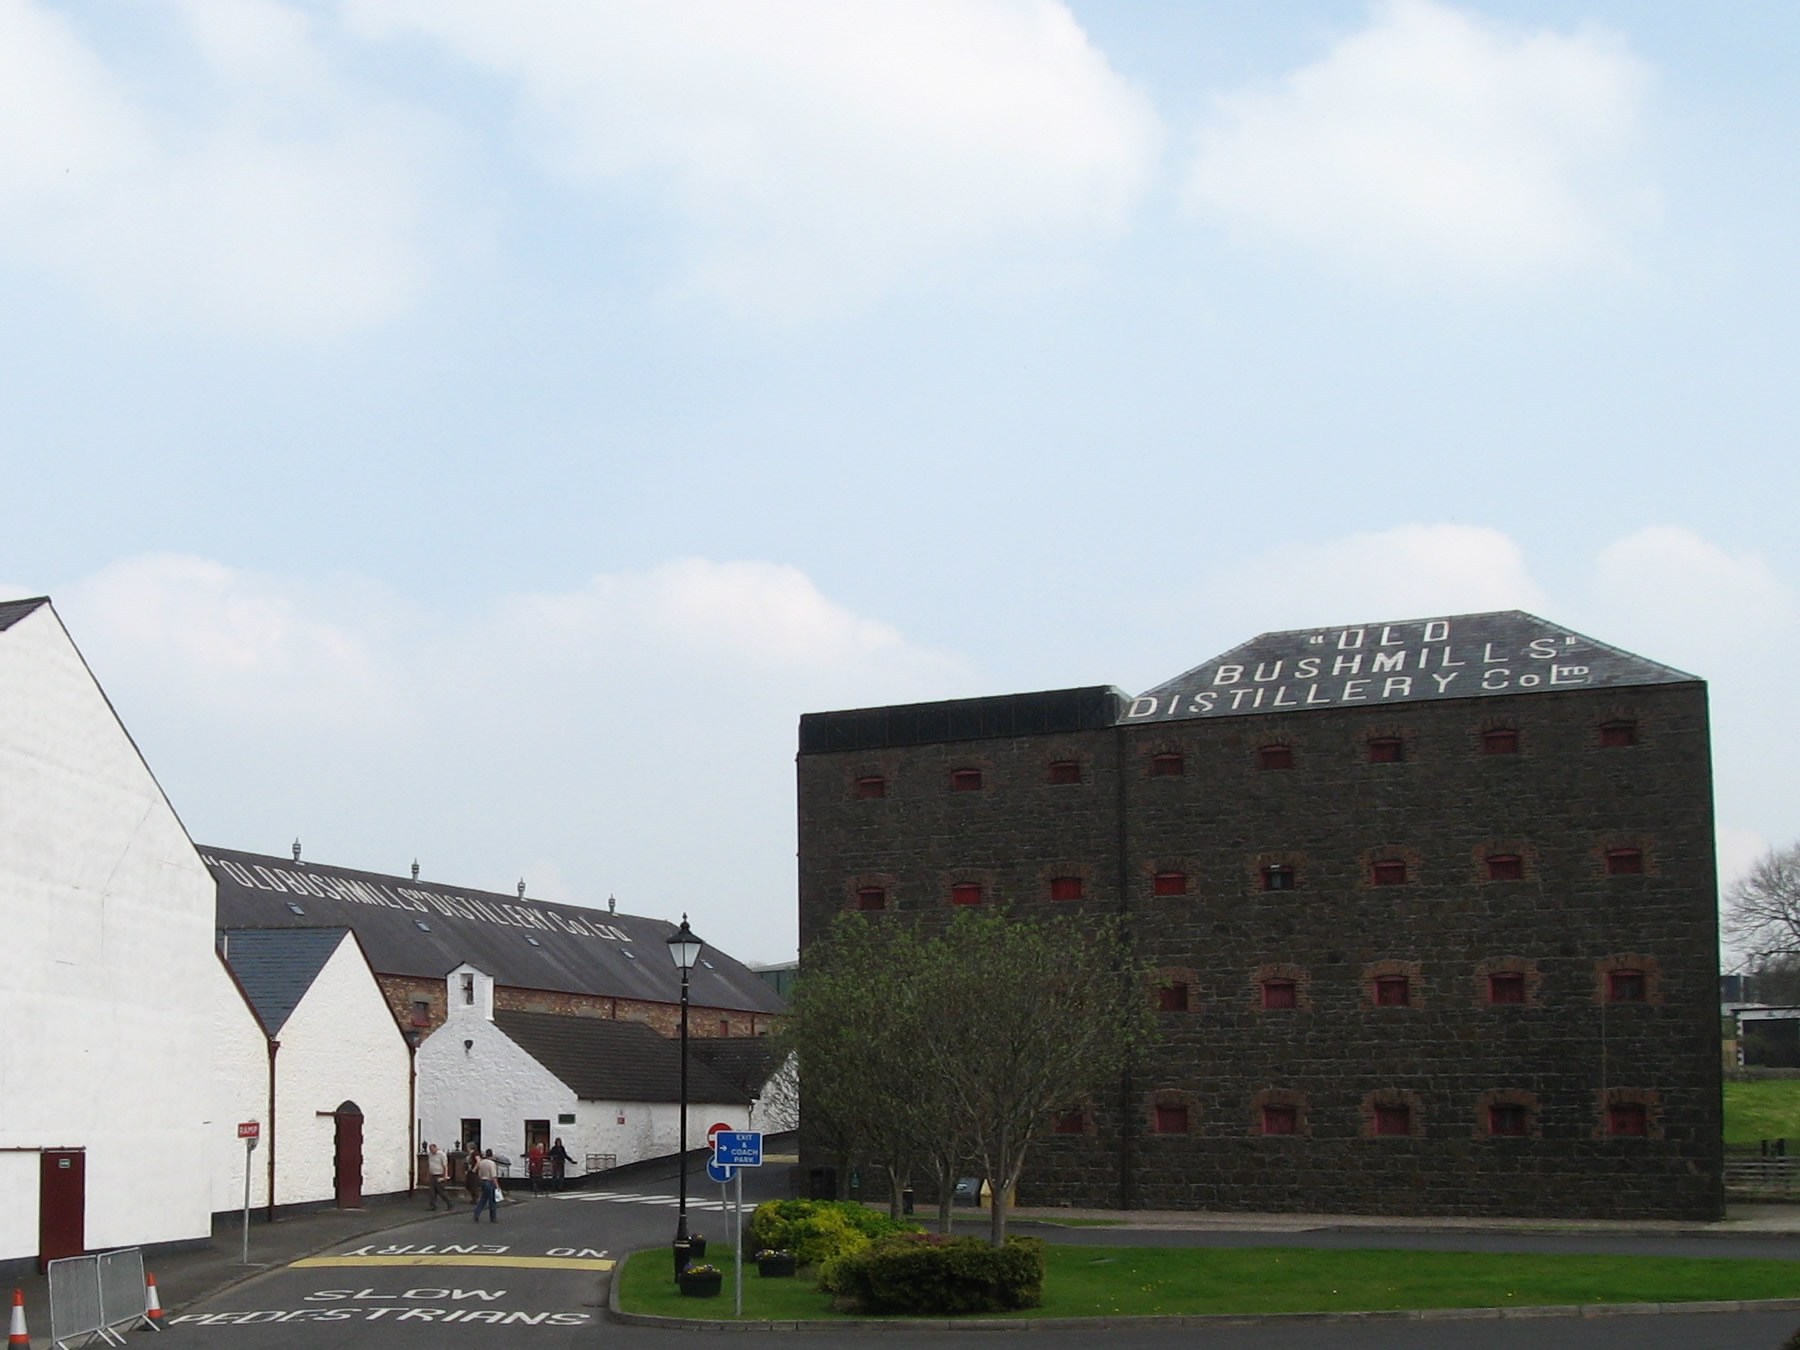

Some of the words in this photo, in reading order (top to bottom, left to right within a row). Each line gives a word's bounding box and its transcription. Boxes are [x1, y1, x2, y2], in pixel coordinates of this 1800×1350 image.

[1127, 670, 1460, 718] DISTILLERY
[419, 891, 558, 932] DISTILLERY
[341, 1244, 511, 1257] ENTRY
[546, 1247, 608, 1258] NO
[303, 1288, 507, 1301] SLOW
[168, 1306, 592, 1327] PEDESTRIANS
